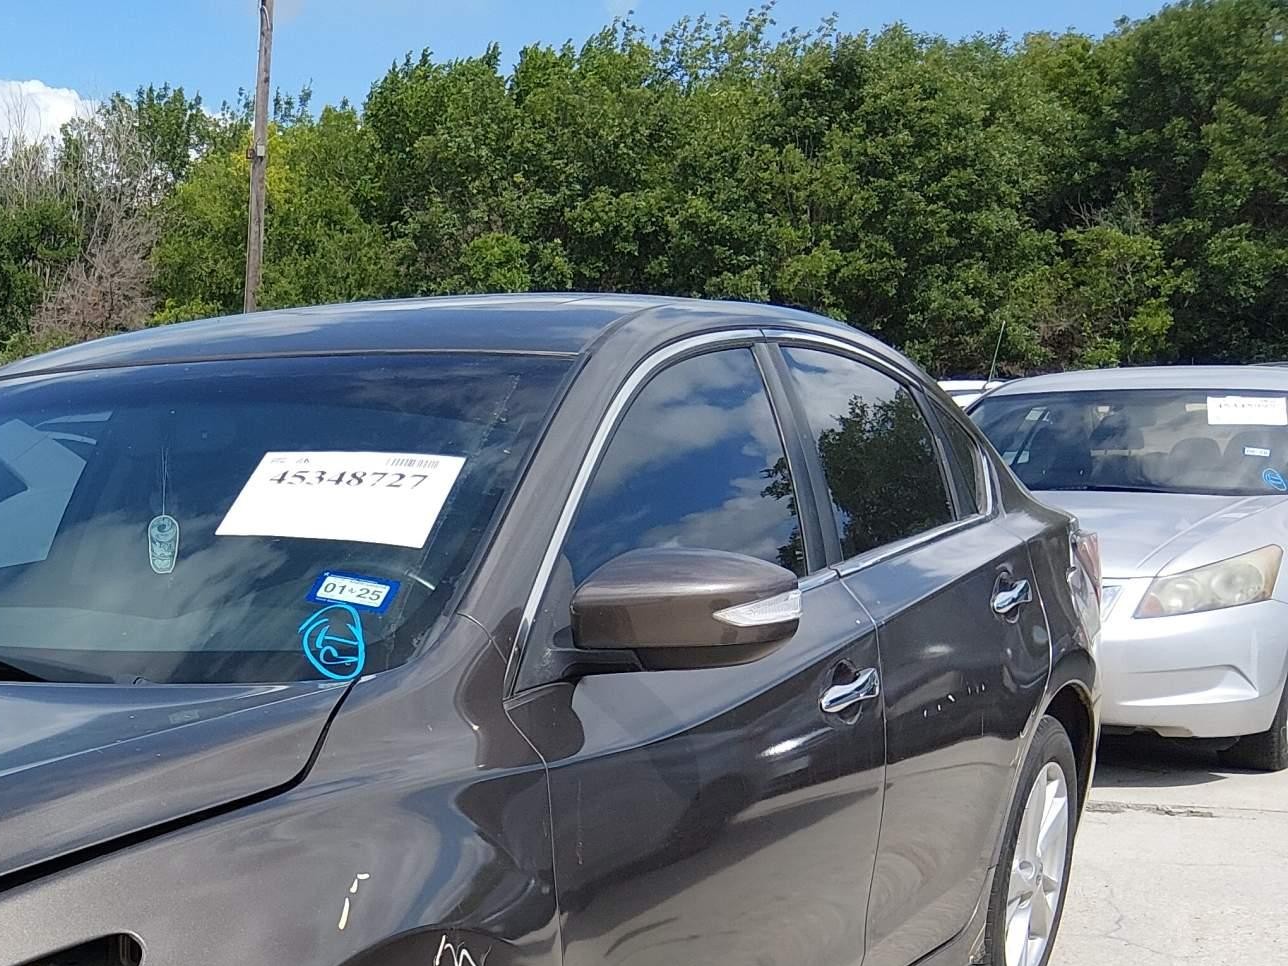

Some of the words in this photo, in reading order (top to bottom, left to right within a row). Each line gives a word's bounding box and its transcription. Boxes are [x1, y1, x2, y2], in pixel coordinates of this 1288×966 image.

[269, 470, 429, 489] 45348727
[323, 582, 347, 595] 01
[356, 588, 383, 601] 25
